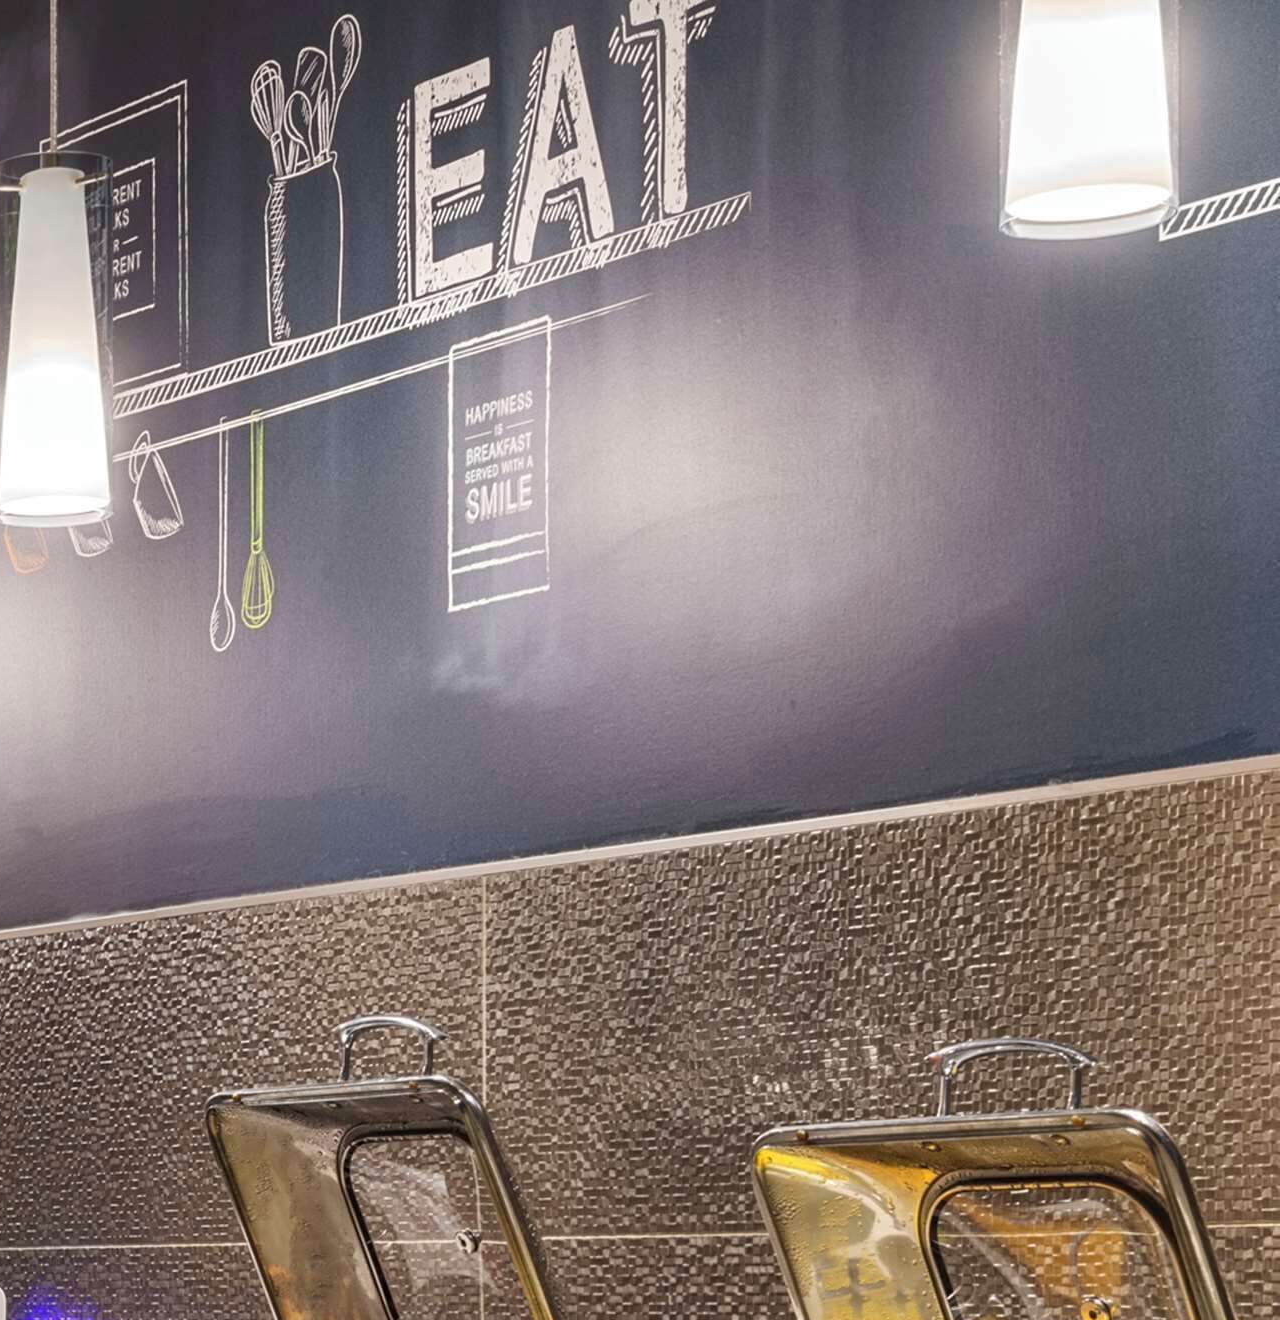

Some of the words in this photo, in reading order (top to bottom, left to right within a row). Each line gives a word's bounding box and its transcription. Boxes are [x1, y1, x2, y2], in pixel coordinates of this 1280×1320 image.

[399, 0, 716, 303] EAT
[465, 390, 534, 427] HAPPINESS
[494, 423, 503, 436] IS
[466, 431, 533, 467] BREAKFAST
[465, 463, 499, 485] SERVED
[501, 457, 525, 475] WITH
[527, 455, 534, 469] A
[465, 473, 533, 524] SMILE
